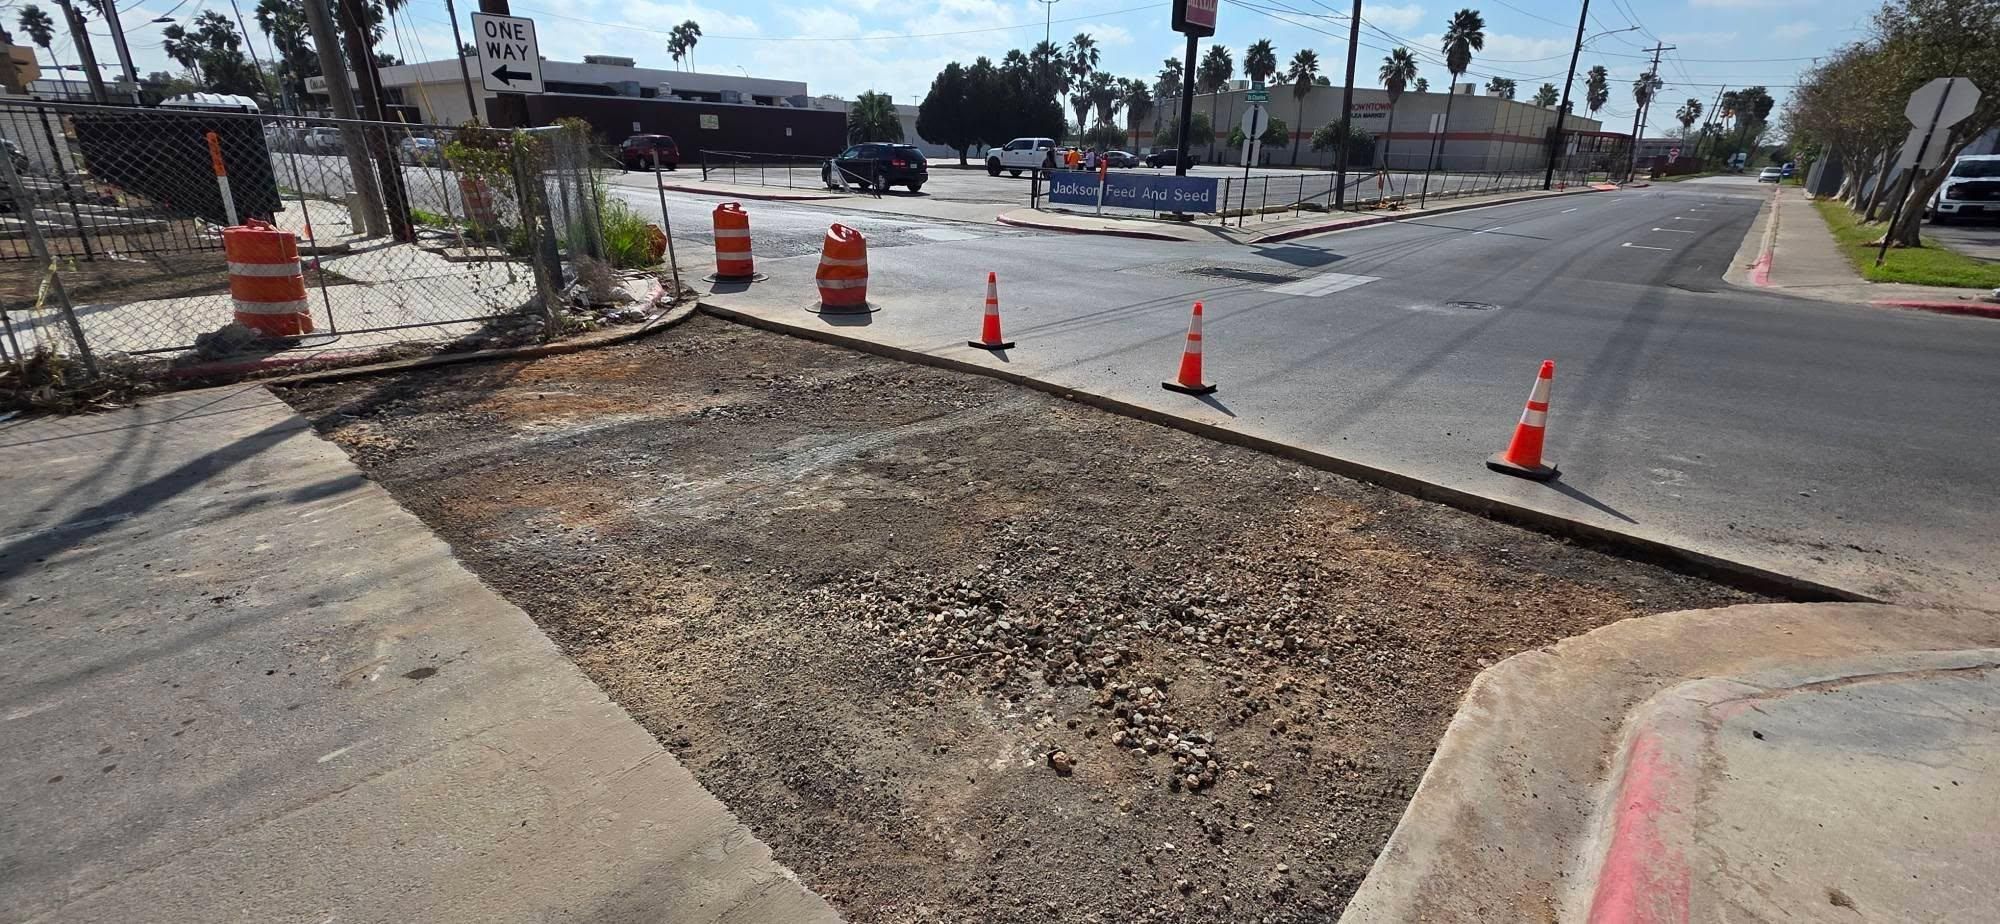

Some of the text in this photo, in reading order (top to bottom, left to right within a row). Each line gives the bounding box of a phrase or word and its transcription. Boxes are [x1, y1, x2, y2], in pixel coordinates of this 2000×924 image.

[484, 20, 526, 41] ONE
[486, 41, 528, 62] WAY
[1053, 181, 1209, 202] Jackson Feed And Seed
